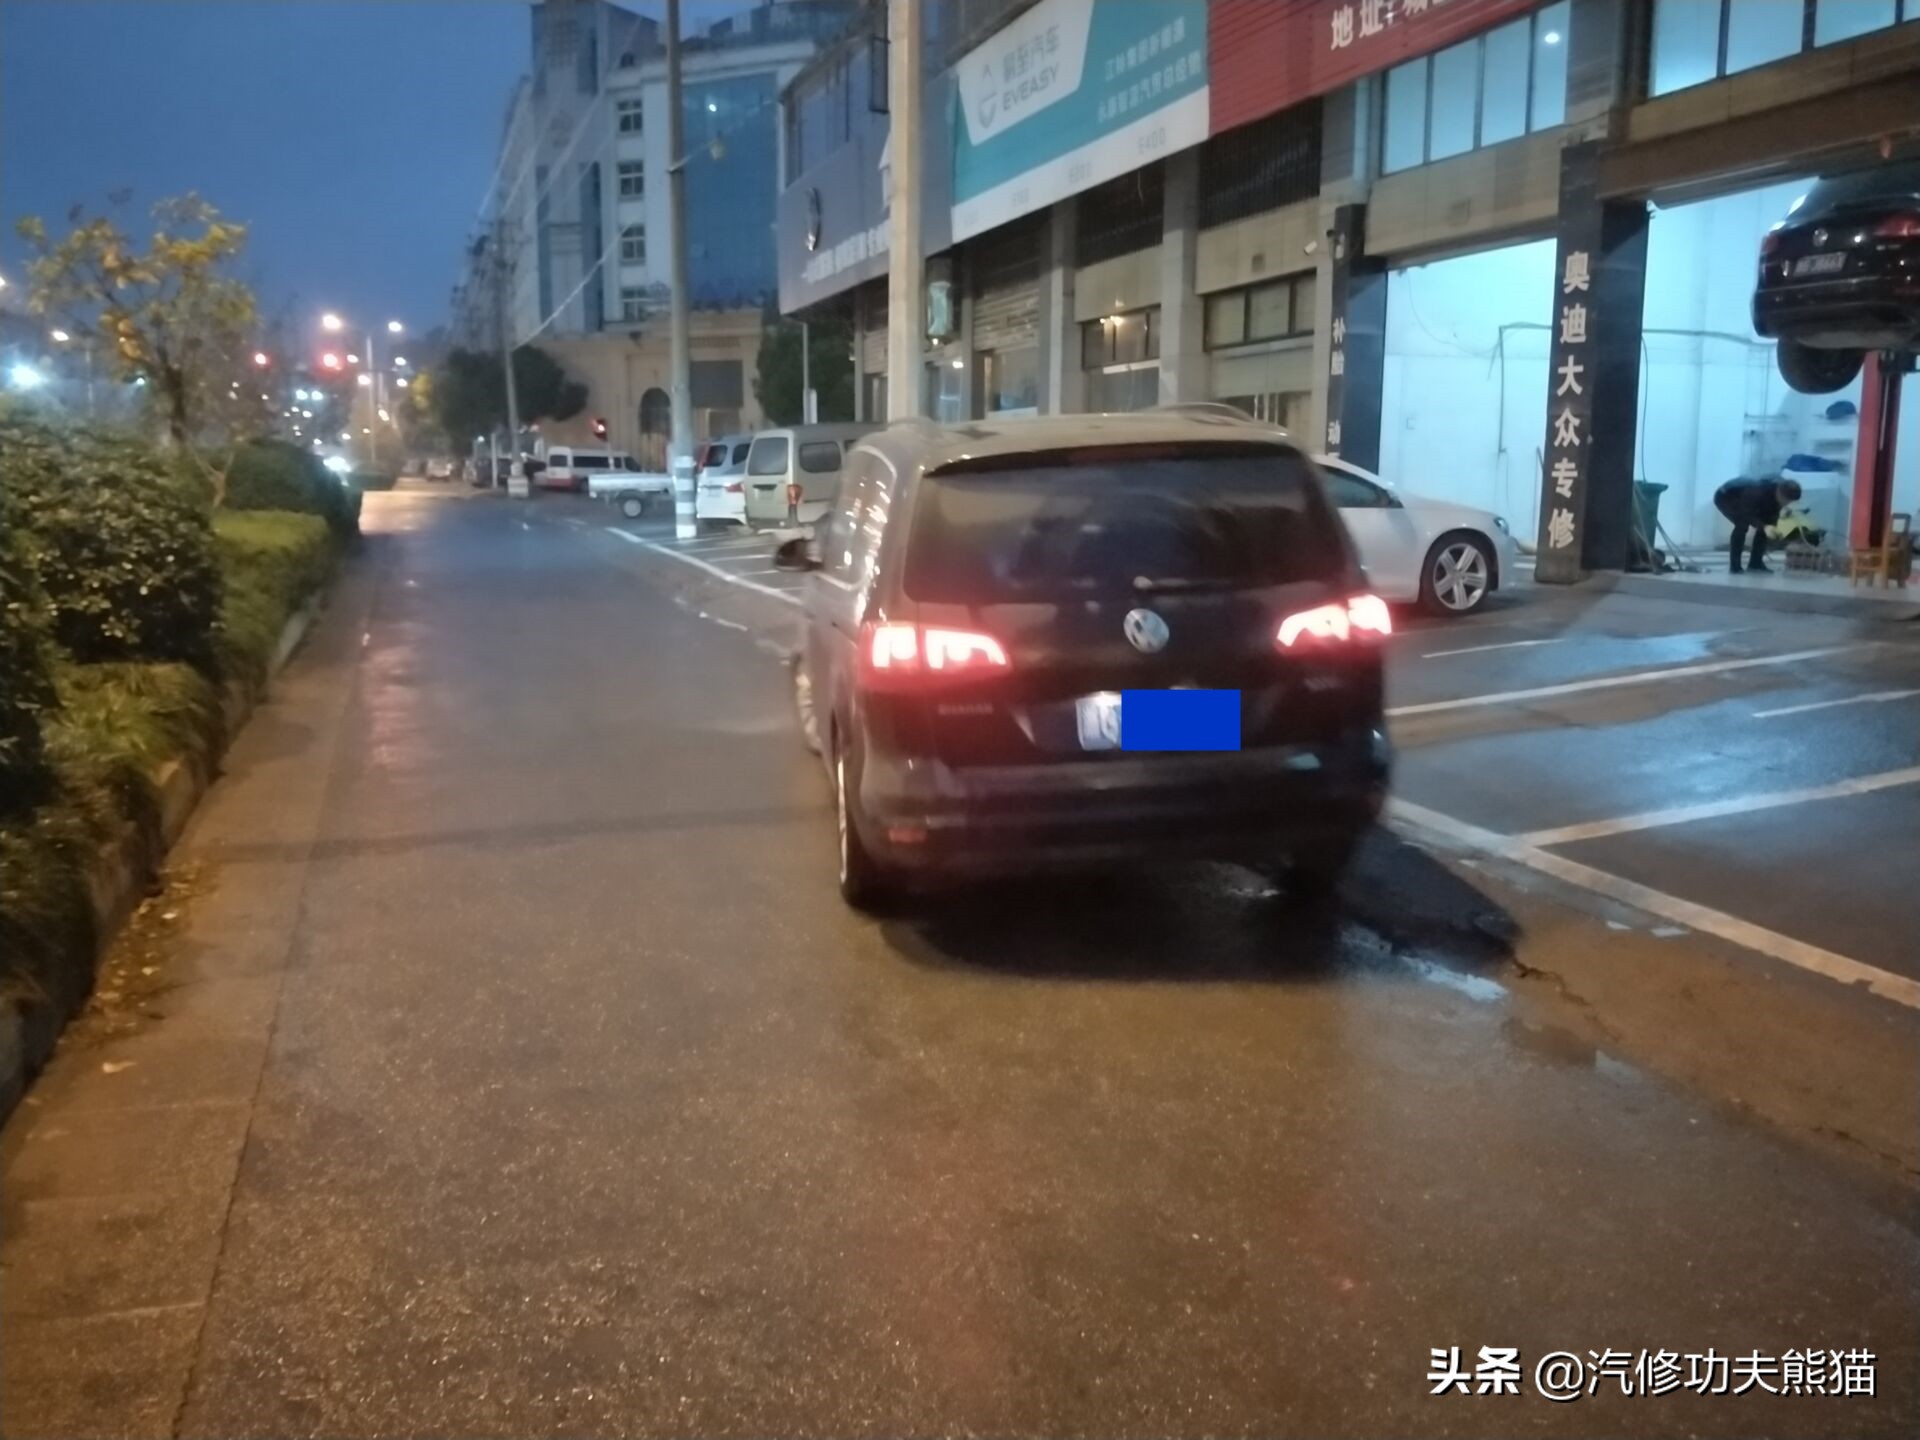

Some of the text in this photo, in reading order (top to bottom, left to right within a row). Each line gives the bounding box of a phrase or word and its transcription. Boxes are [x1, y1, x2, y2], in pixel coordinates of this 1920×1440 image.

[1549, 251, 1590, 549] 奥迪大众专修
